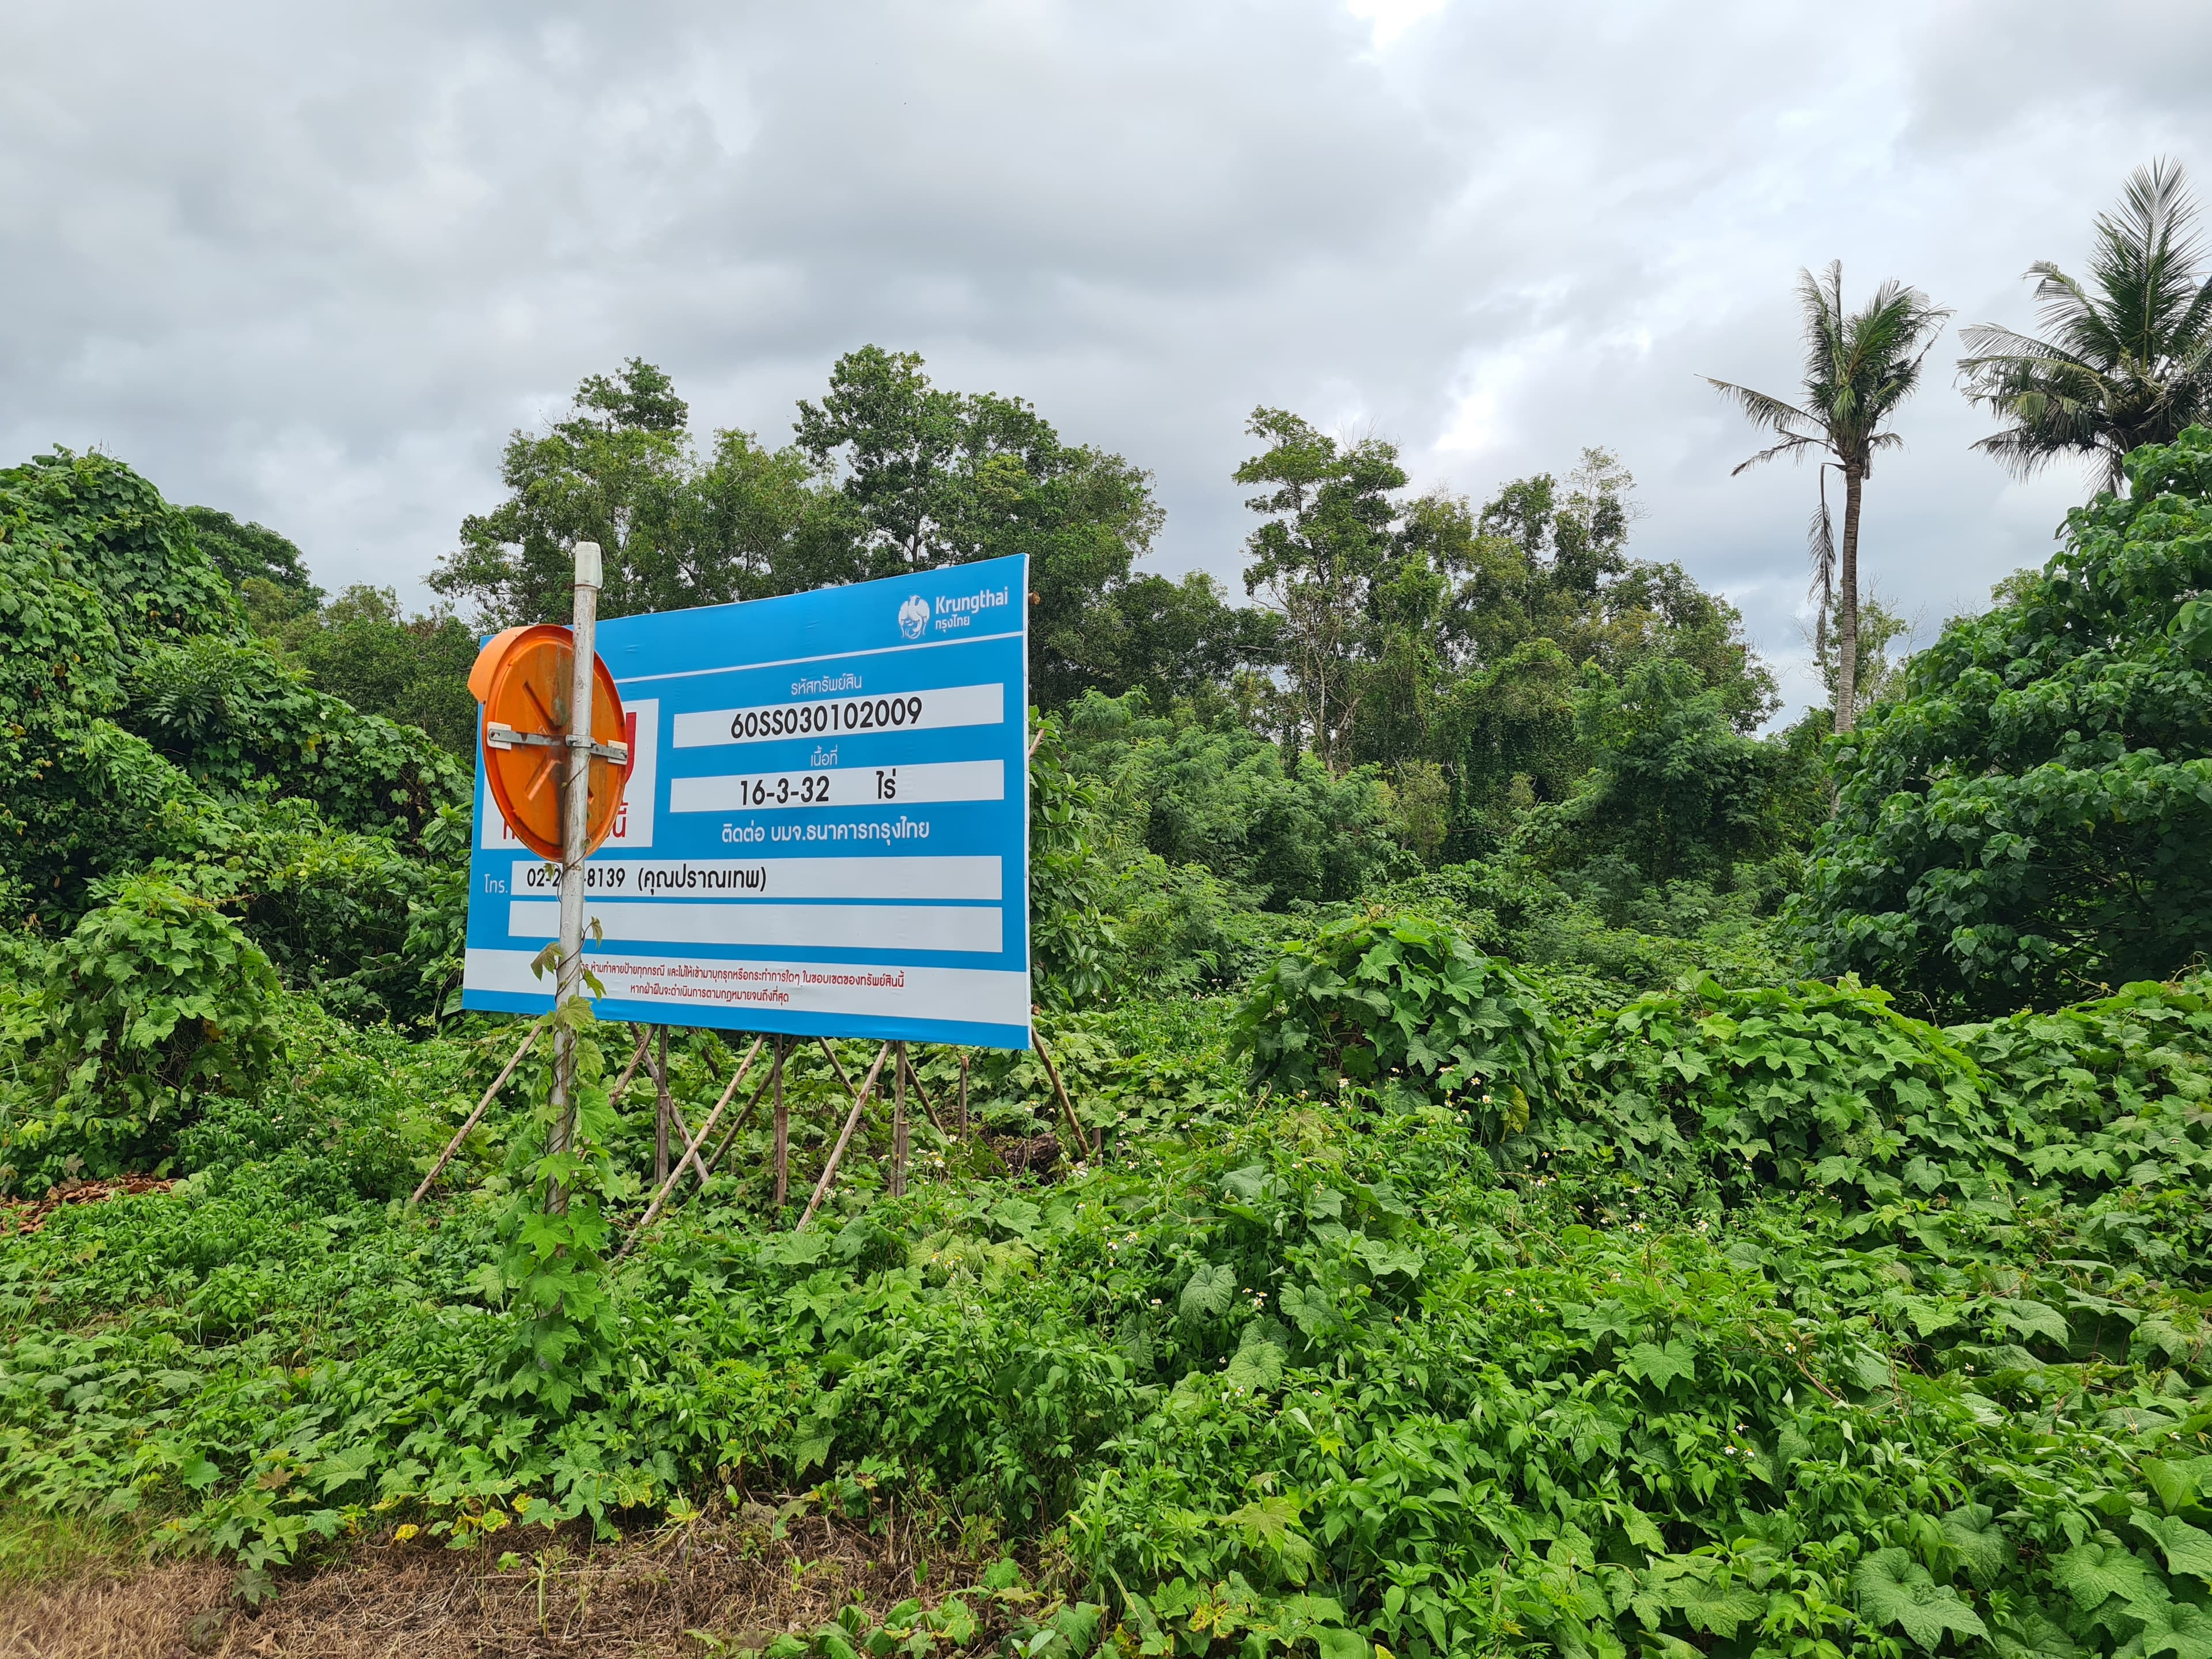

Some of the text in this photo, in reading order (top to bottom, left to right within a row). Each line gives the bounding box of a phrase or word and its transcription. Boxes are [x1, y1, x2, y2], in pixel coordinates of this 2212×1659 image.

[935, 586, 1008, 615] Krungthai
[935, 614, 970, 633] กรุงไทย
[791, 673, 862, 695] รหัสทรัพย์สิน
[731, 696, 922, 739] 60SS030102009
[810, 745, 838, 767] เนื้อที่
[740, 768, 896, 805] 16-3-32 ไร่
[722, 816, 930, 846] ติดต่อ บมจ.ธนาคารกรุงไทย
[484, 863, 766, 896] โทร. 02-28139 (คุณปราณเทพ)
[591, 960, 665, 979] ห้ามทำลายป้ายทุกกรณี
